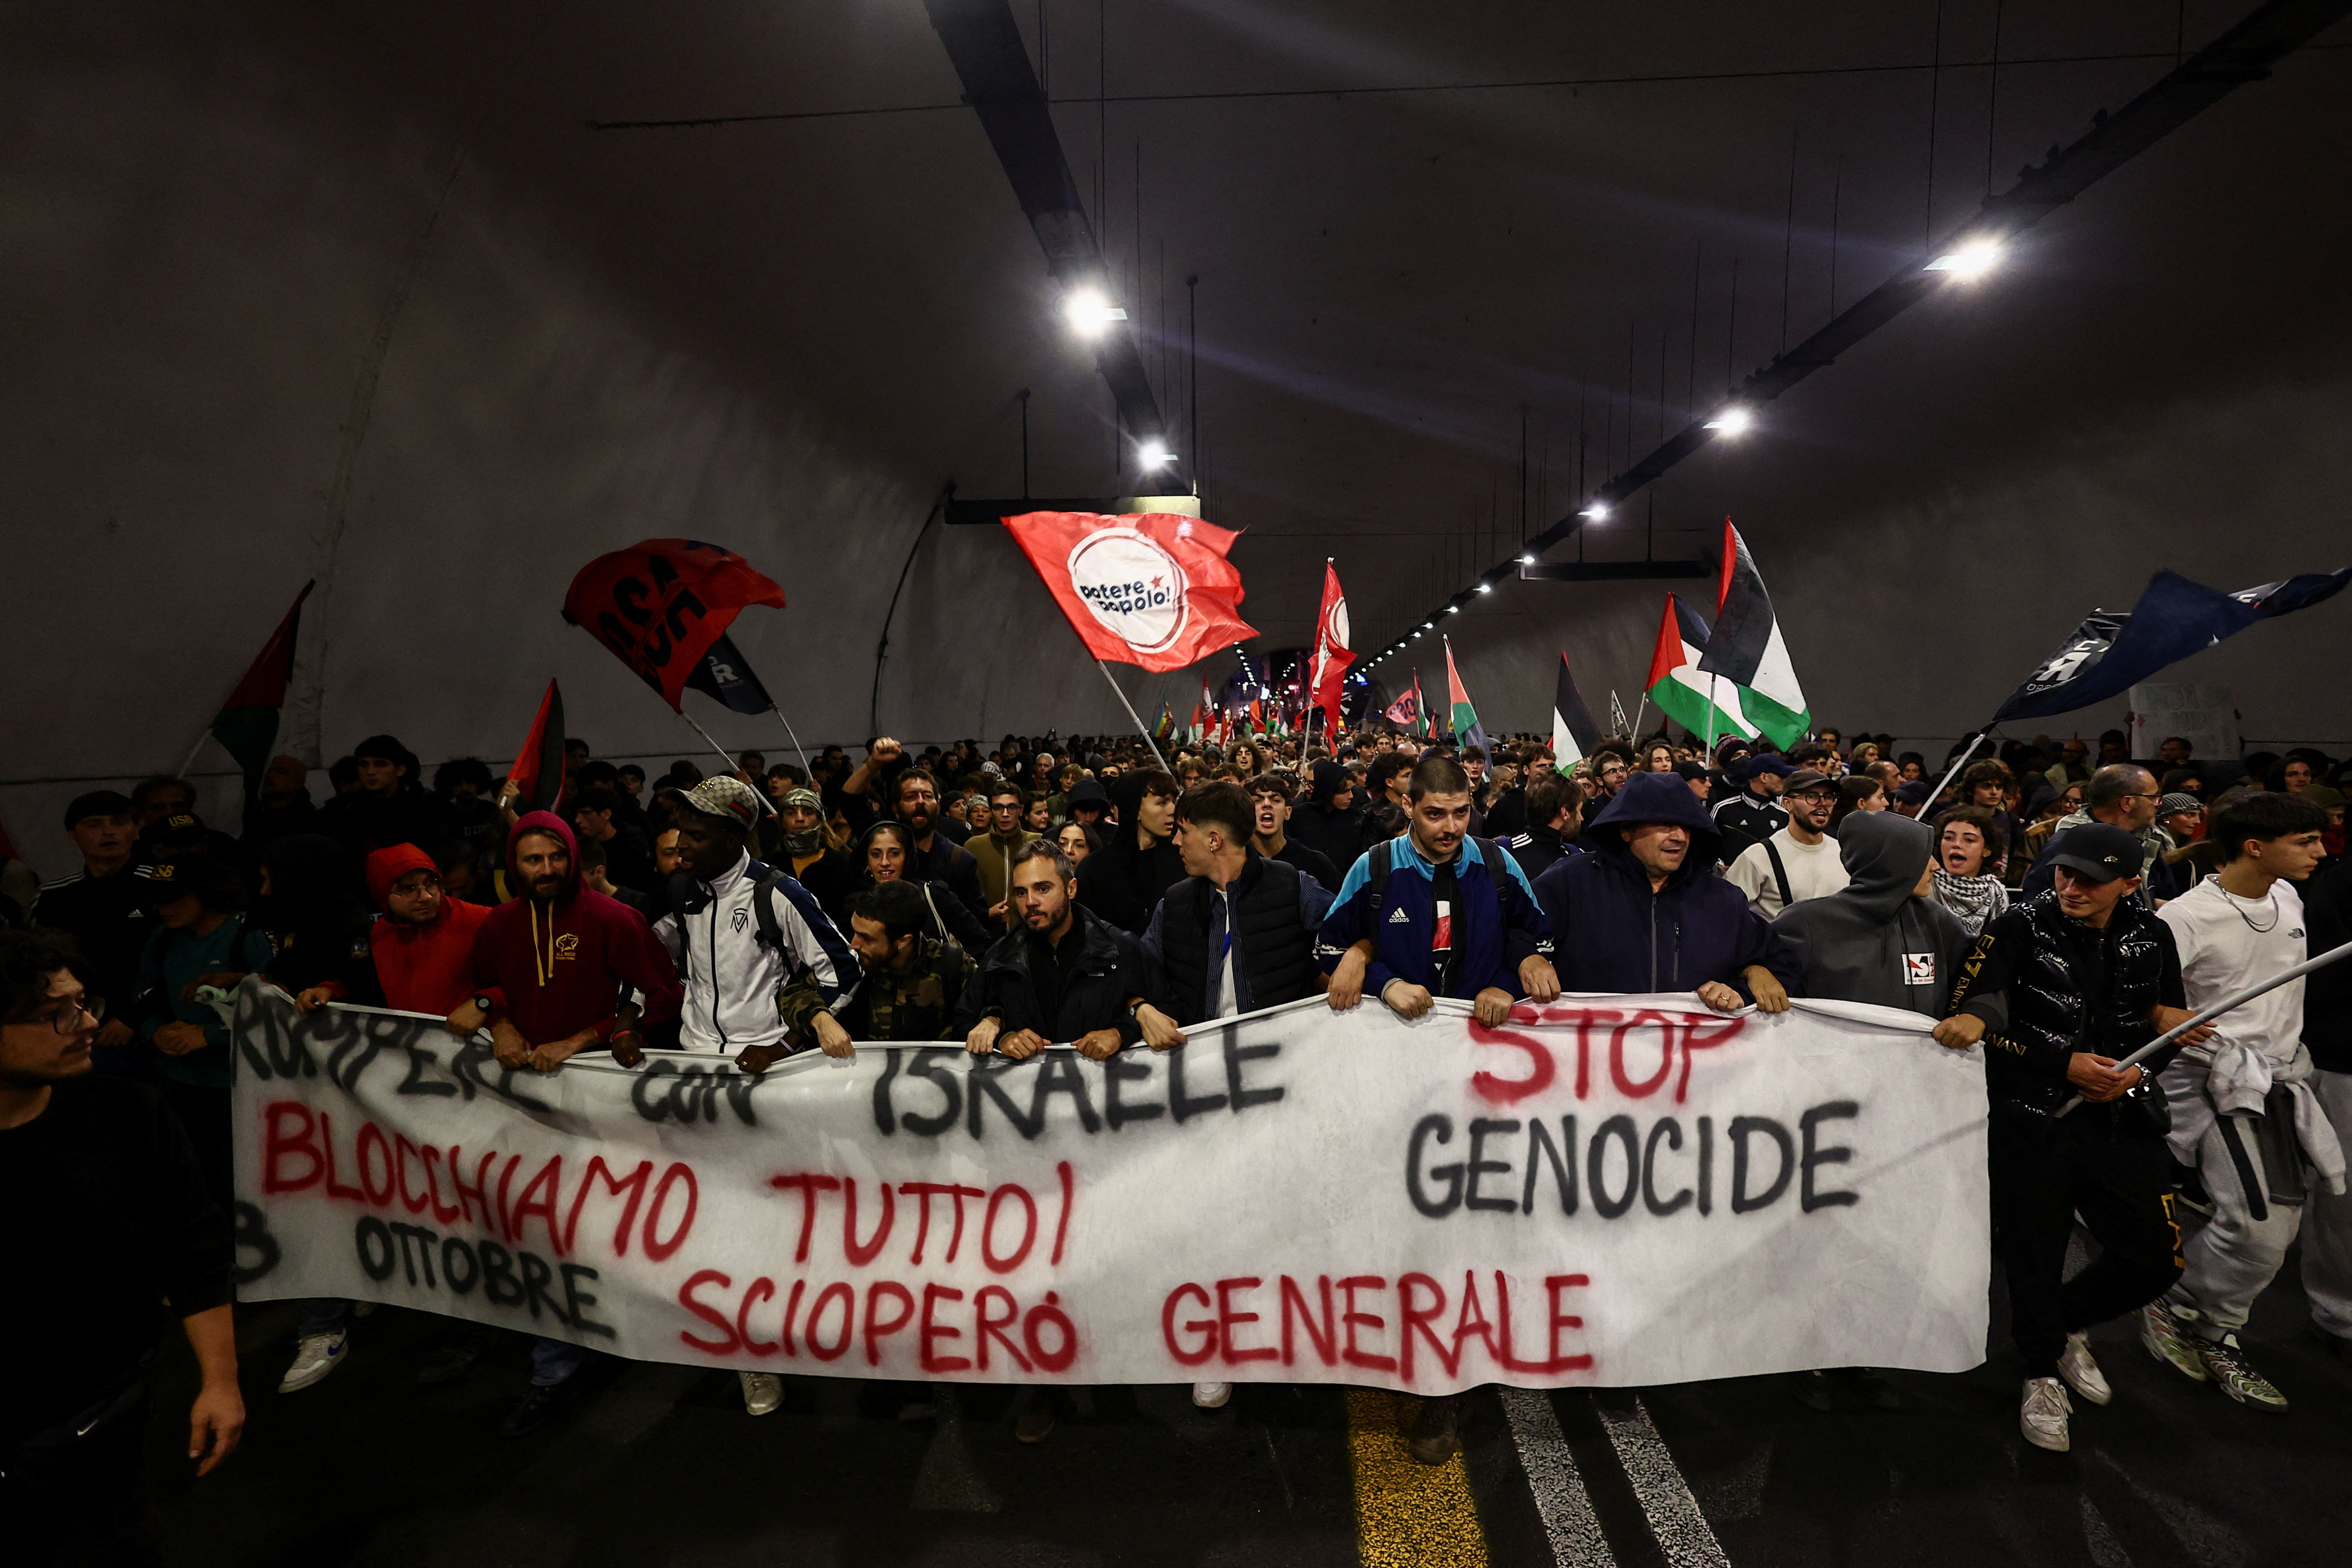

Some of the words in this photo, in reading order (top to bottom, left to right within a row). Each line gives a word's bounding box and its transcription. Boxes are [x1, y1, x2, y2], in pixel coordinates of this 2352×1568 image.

[1080, 581, 1145, 599] potere
[1098, 586, 1170, 615] popolo!
[168, 815, 195, 826] USB
[1964, 934, 1995, 978] EA7
[873, 1025, 1285, 1138] ISRAELE
[1468, 1005, 1746, 1104] STOP
[263, 1101, 698, 1262] BLOCCHIAMO
[769, 1160, 1073, 1305] TUTTO!
[1406, 1101, 1860, 1219] GENOCIDE
[355, 1215, 616, 1340] OTTOBRE
[1161, 1269, 1594, 1383] GENERALE
